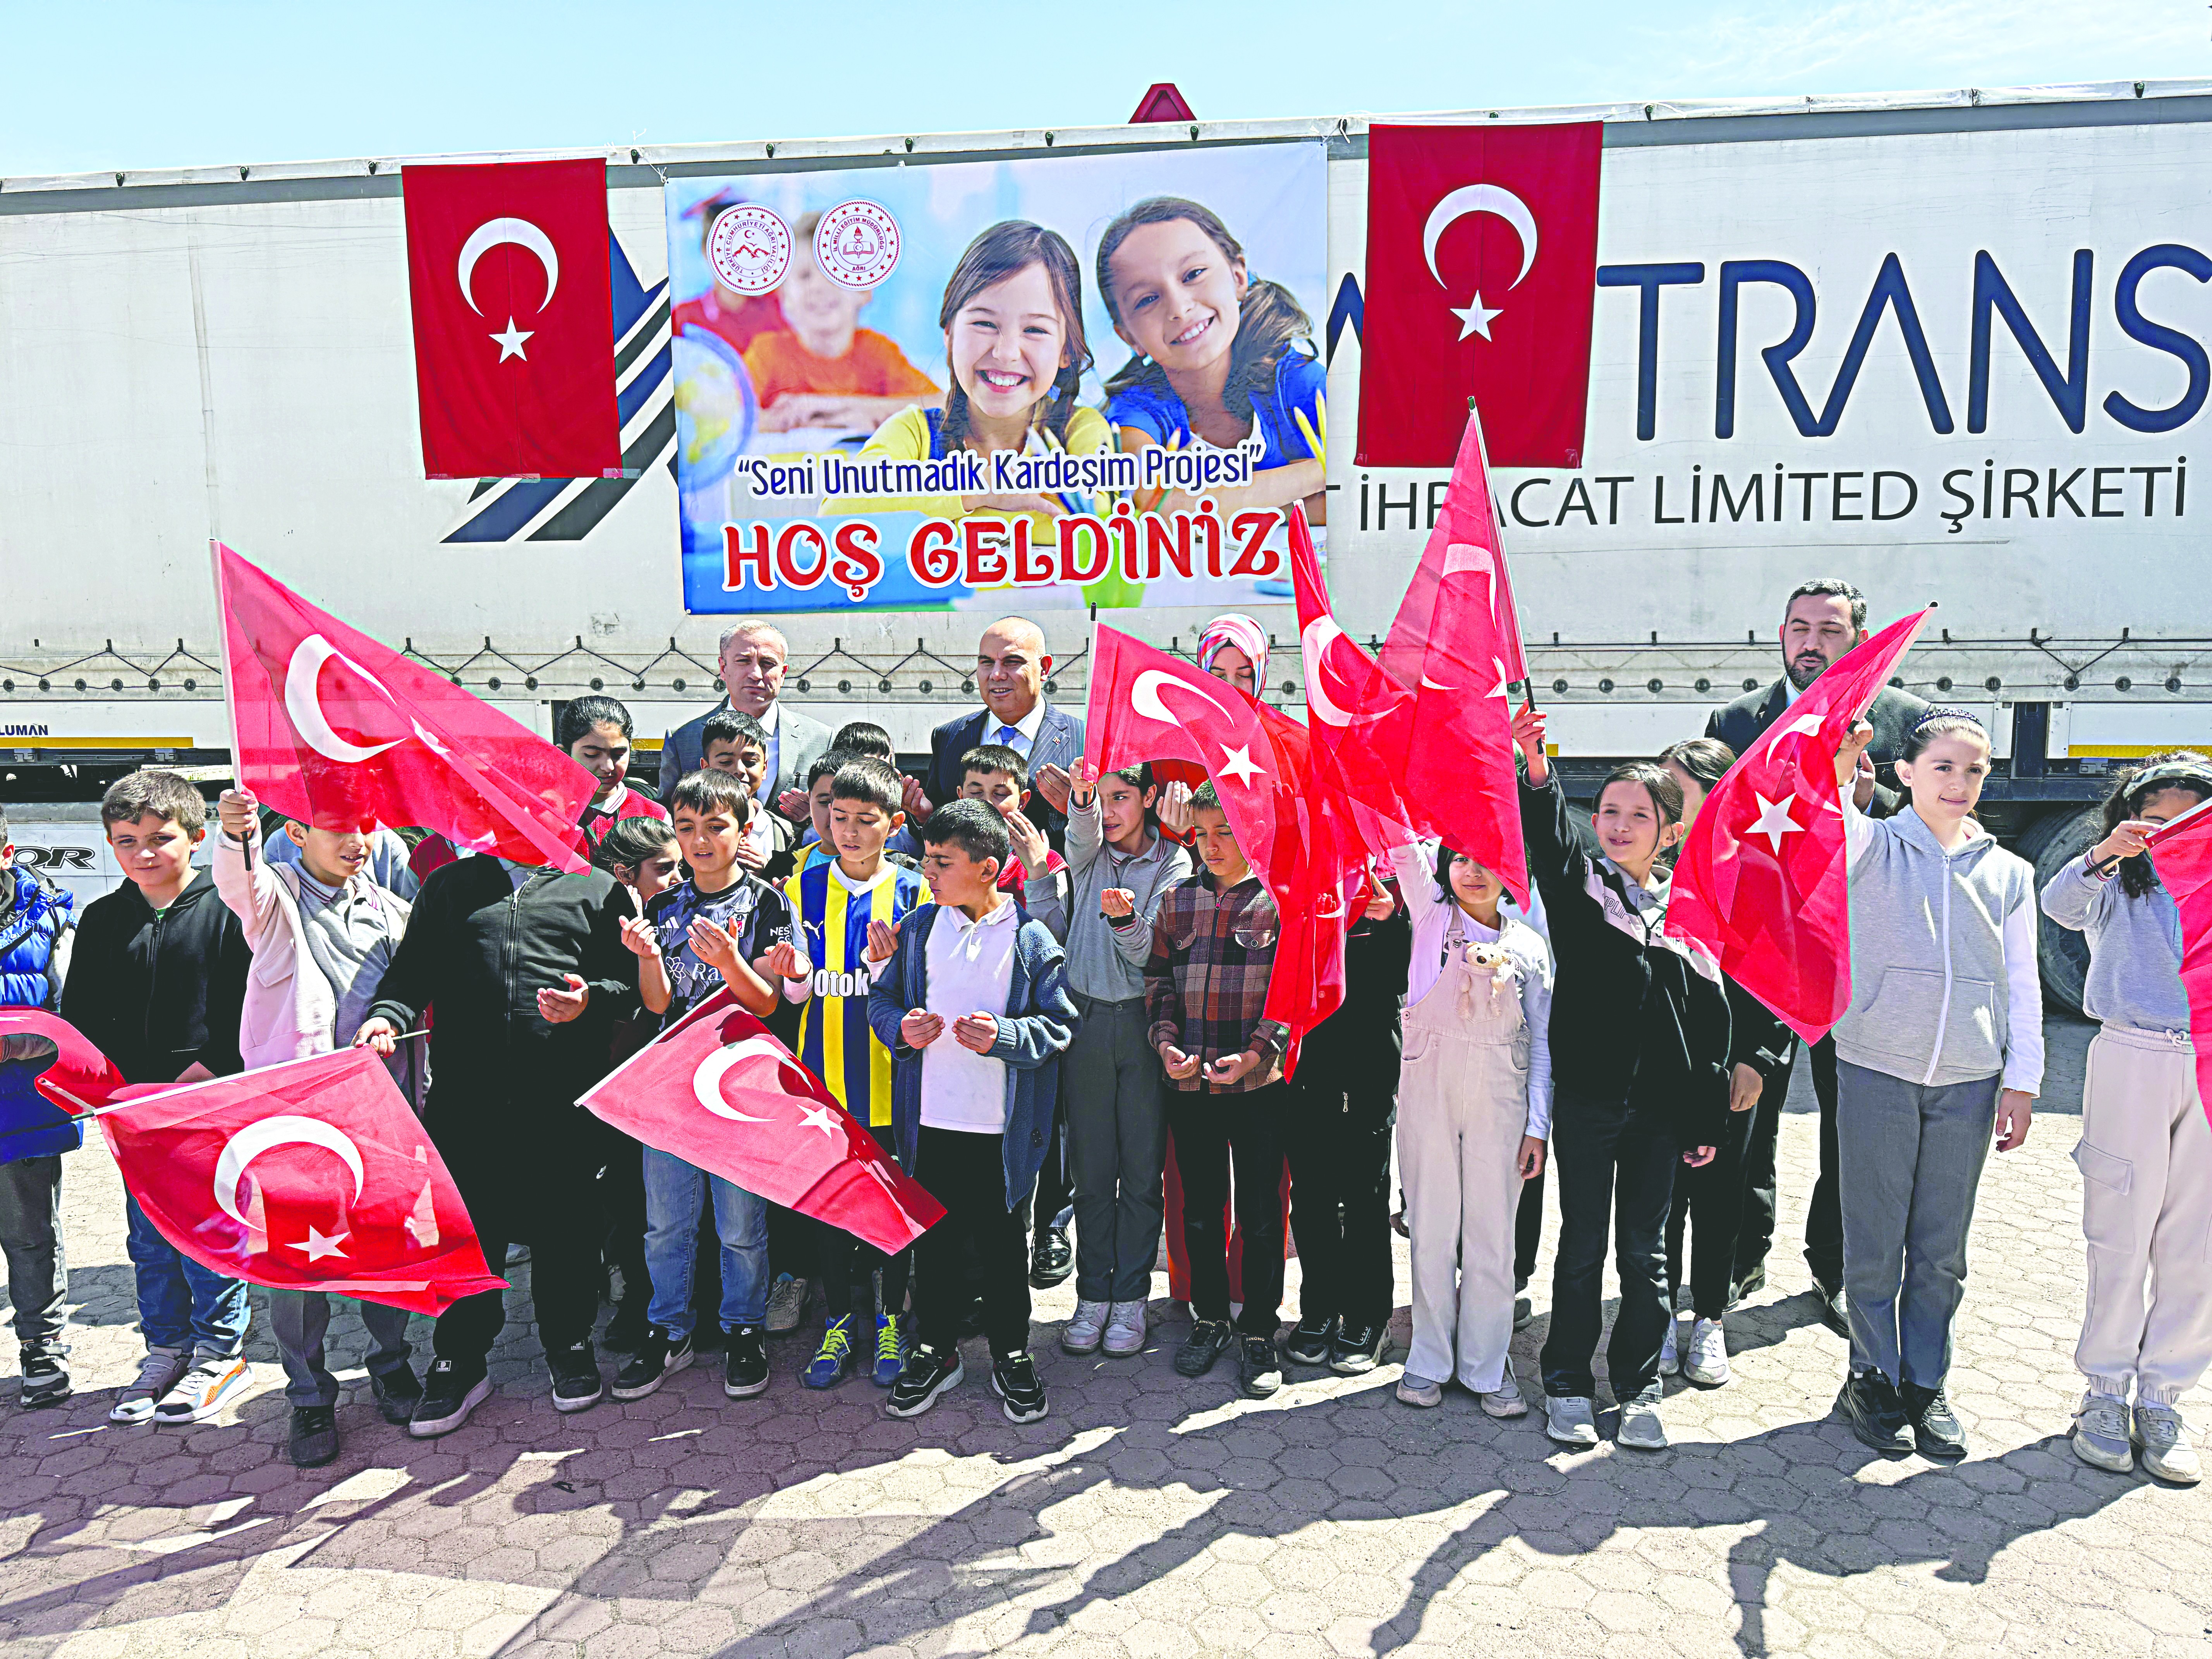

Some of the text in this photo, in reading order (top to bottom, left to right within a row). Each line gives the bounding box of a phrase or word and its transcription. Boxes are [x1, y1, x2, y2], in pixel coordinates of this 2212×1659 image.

[1596, 244, 2212, 441] TRANS
[824, 455, 985, 494] Unutmadık
[995, 450, 1134, 494] Kardeşim
[1360, 456, 2186, 534] İHCAT LİMİTED ŞİRKETİ
[725, 500, 1280, 597] HOŞ GELDİNİZ
